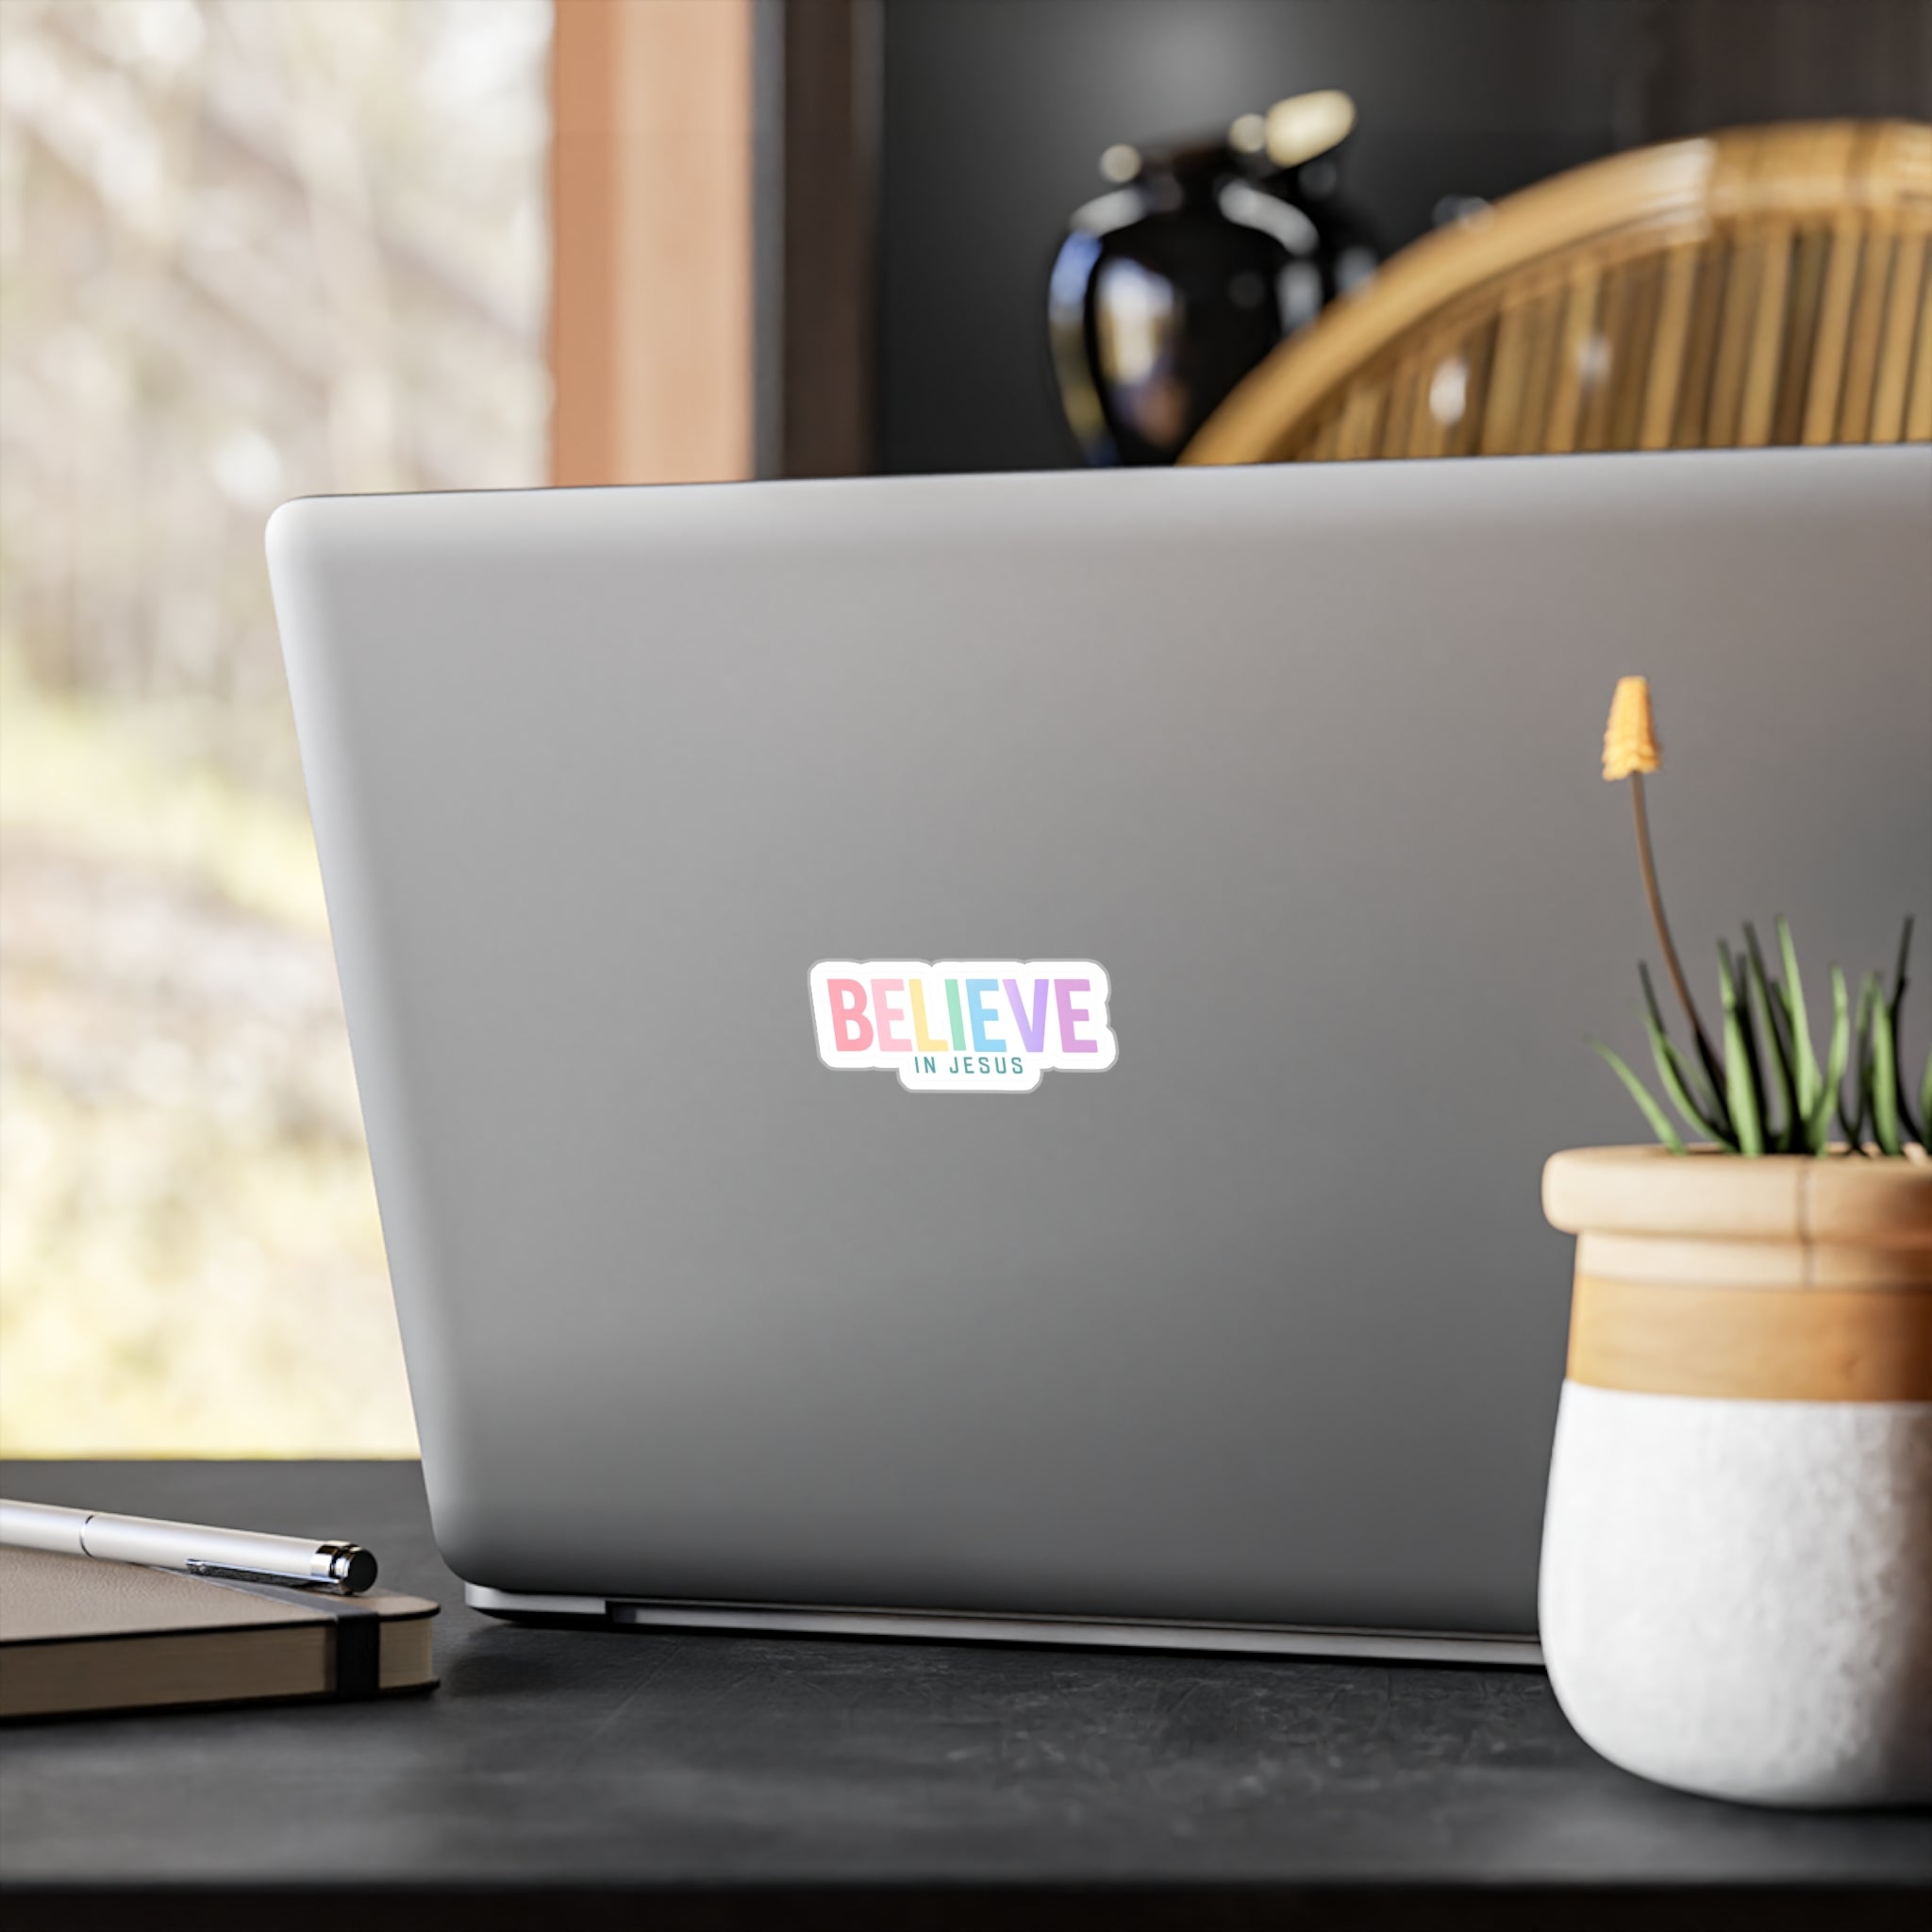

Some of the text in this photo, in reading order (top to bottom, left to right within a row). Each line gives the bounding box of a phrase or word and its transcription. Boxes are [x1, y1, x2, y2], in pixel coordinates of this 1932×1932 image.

[826, 978, 1098, 1053] BELIEVE
[914, 1056, 1024, 1074] IN JESUS
